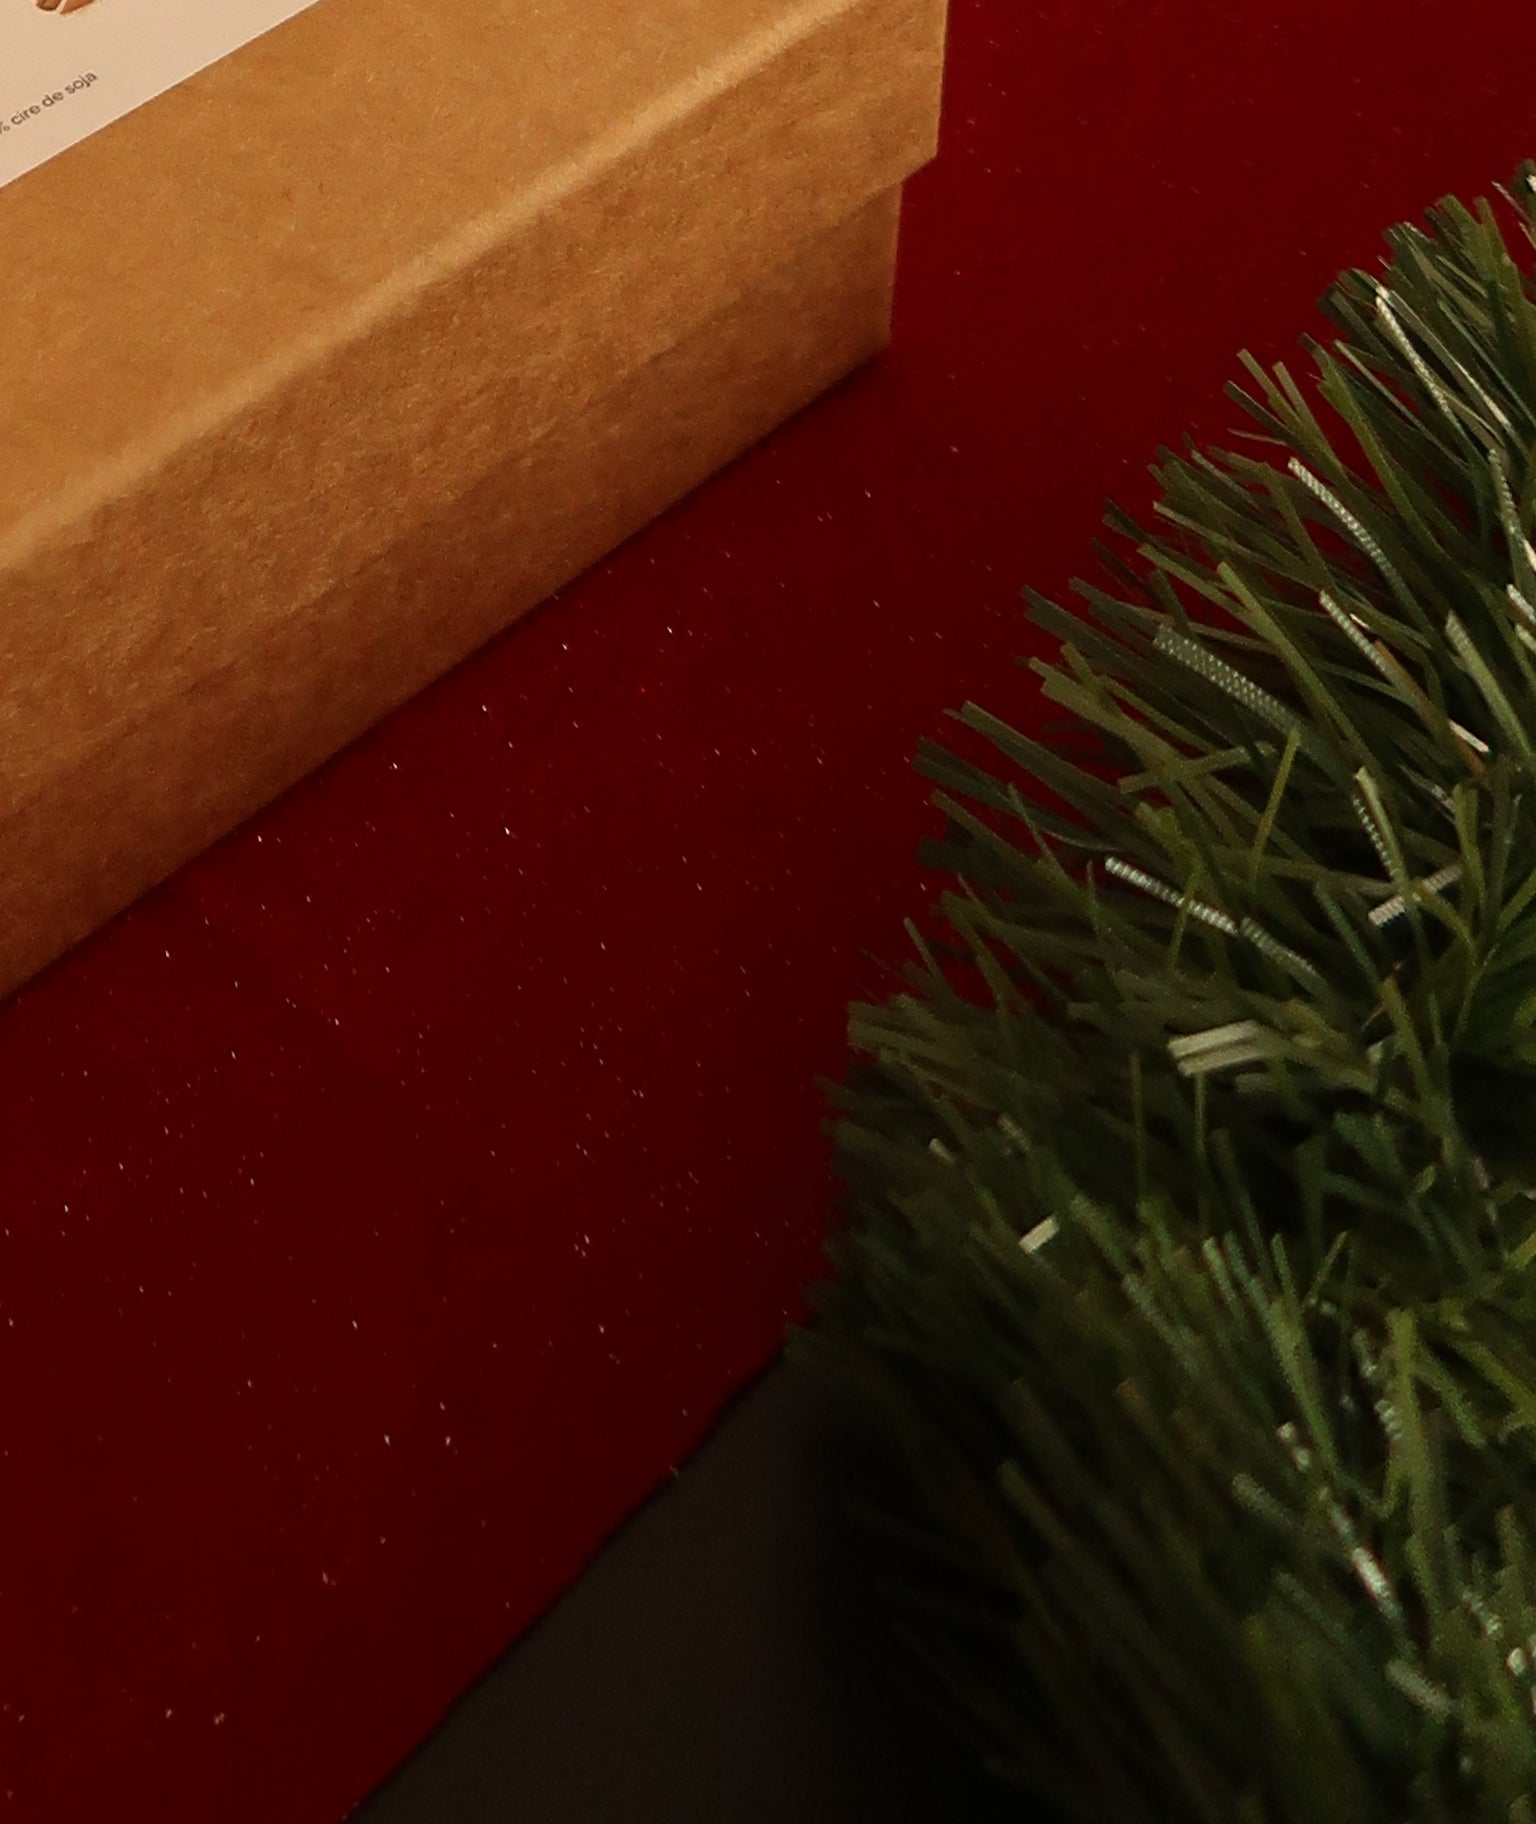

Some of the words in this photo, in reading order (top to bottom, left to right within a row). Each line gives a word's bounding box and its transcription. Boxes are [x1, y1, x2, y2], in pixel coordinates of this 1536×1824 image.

[10, 101, 41, 127] cire
[41, 91, 64, 109] de
[64, 70, 99, 95] soja
